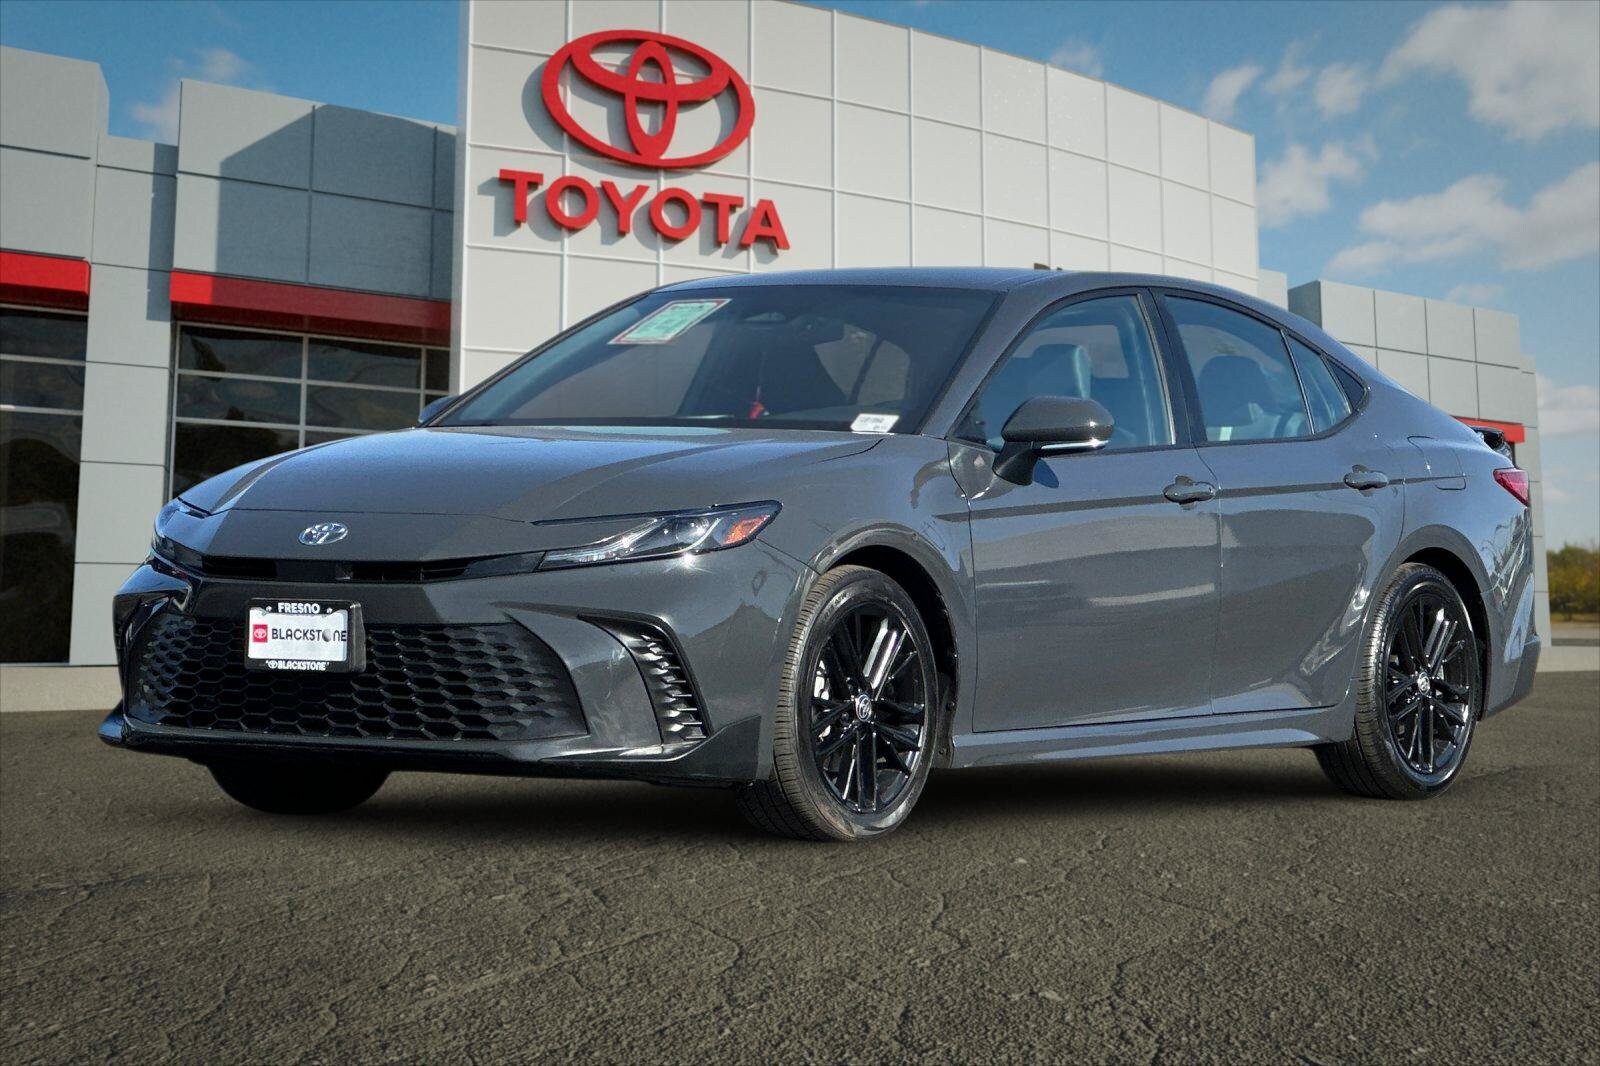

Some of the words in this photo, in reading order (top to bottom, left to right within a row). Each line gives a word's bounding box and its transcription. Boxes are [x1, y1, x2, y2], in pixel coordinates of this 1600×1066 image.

[499, 169, 790, 250] TOYOTA
[278, 602, 320, 614] FRESNO
[271, 628, 347, 642] BLACKSTONE
